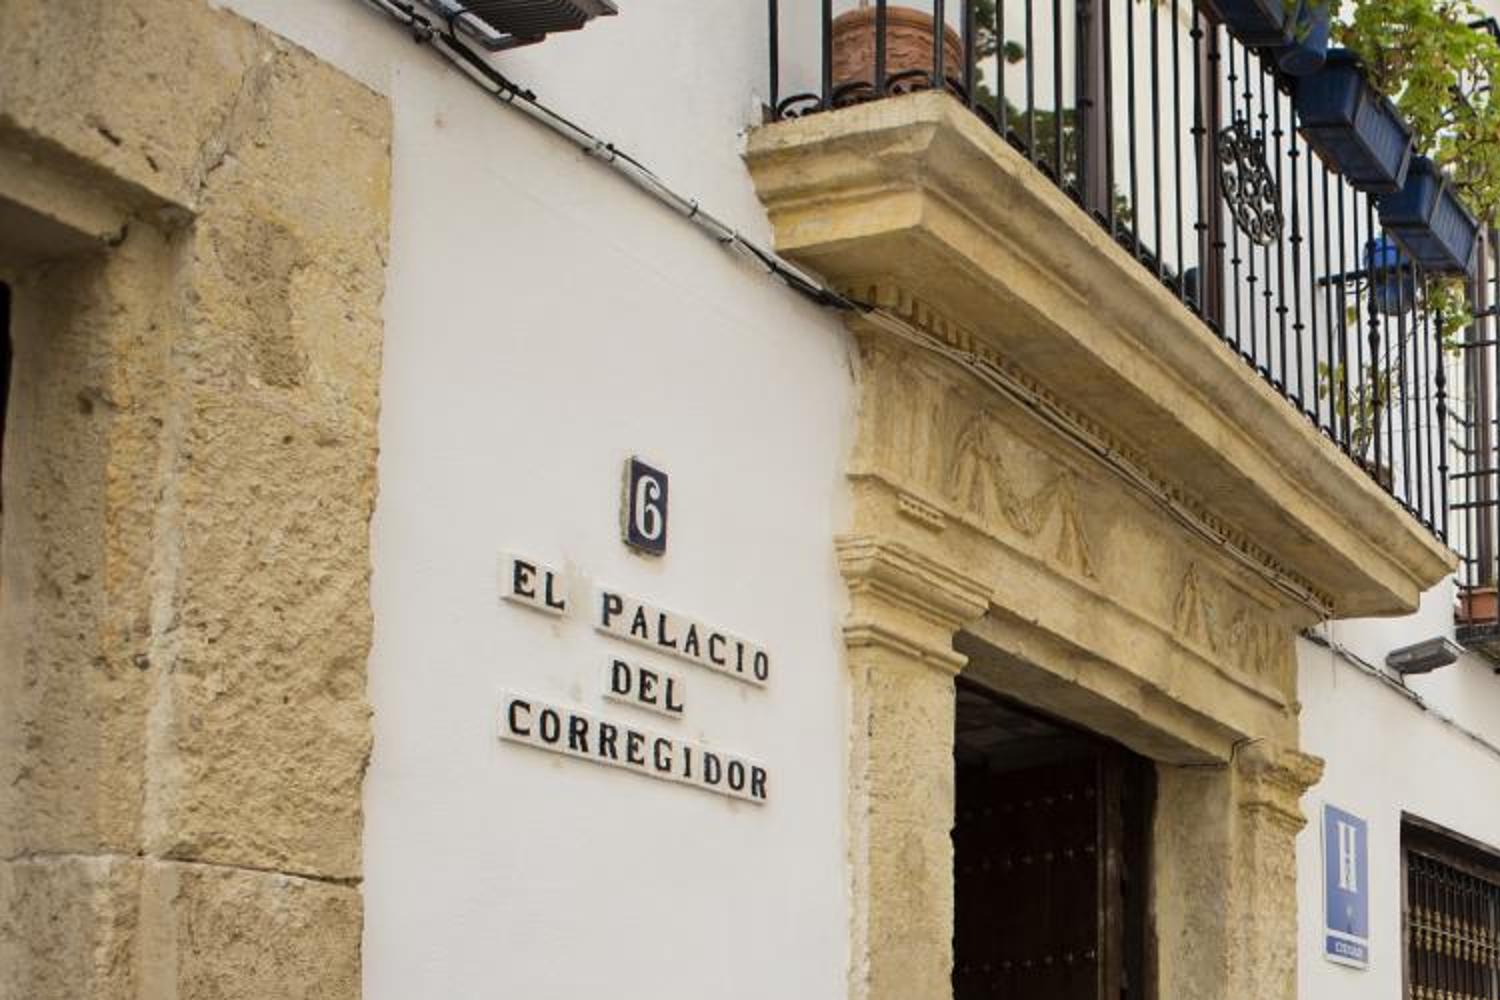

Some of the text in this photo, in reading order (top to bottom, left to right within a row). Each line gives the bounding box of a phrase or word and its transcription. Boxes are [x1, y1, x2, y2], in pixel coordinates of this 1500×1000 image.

[635, 475, 662, 540] 6
[512, 559, 769, 681] EL PALACIO
[611, 659, 684, 713] DEL
[508, 699, 768, 799] CORREGIDOR
